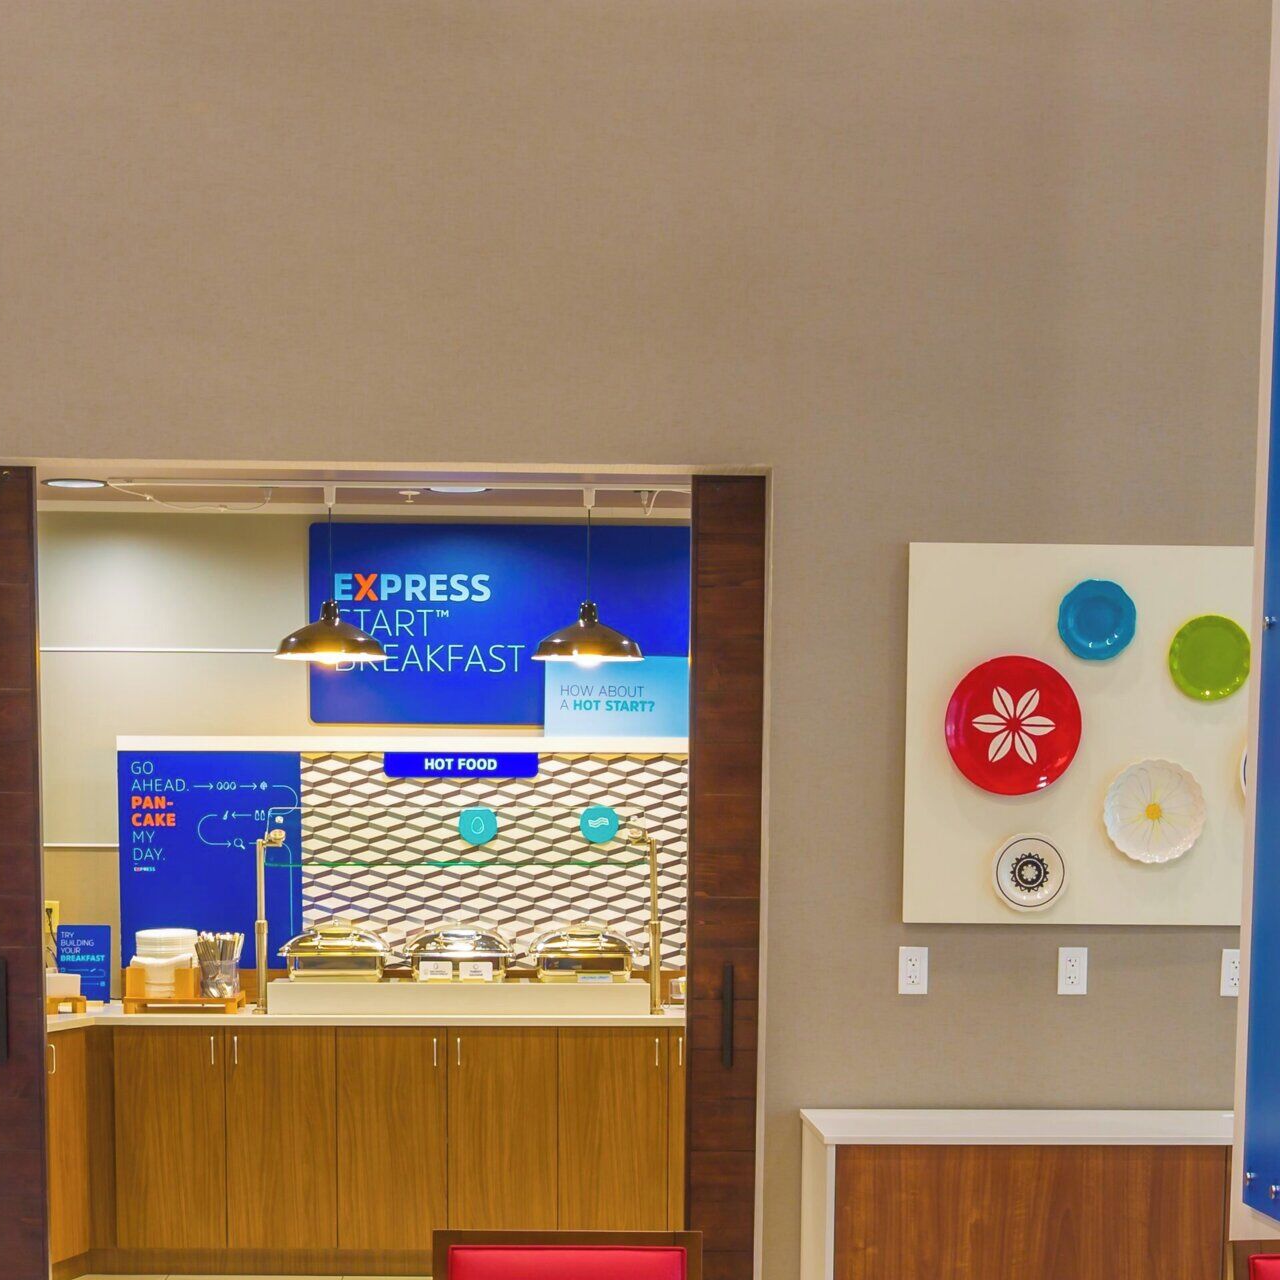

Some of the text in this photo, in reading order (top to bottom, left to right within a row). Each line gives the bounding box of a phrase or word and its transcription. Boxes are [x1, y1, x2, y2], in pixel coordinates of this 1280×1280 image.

[334, 573, 491, 602] EXPRESS
[338, 609, 449, 637] TART™
[560, 685, 644, 698] HOW ABOUT
[560, 700, 656, 713] A HOT START?
[131, 761, 154, 775] GO
[424, 758, 498, 771] HOT FOOD
[131, 778, 190, 792] AHEAD.
[131, 796, 174, 809] PAN-
[131, 813, 176, 827] CAKE
[132, 831, 155, 843] MY
[133, 848, 166, 861] DAY.
[60, 939, 95, 947] BUILDING
[60, 954, 105, 962] BREAKFAST
